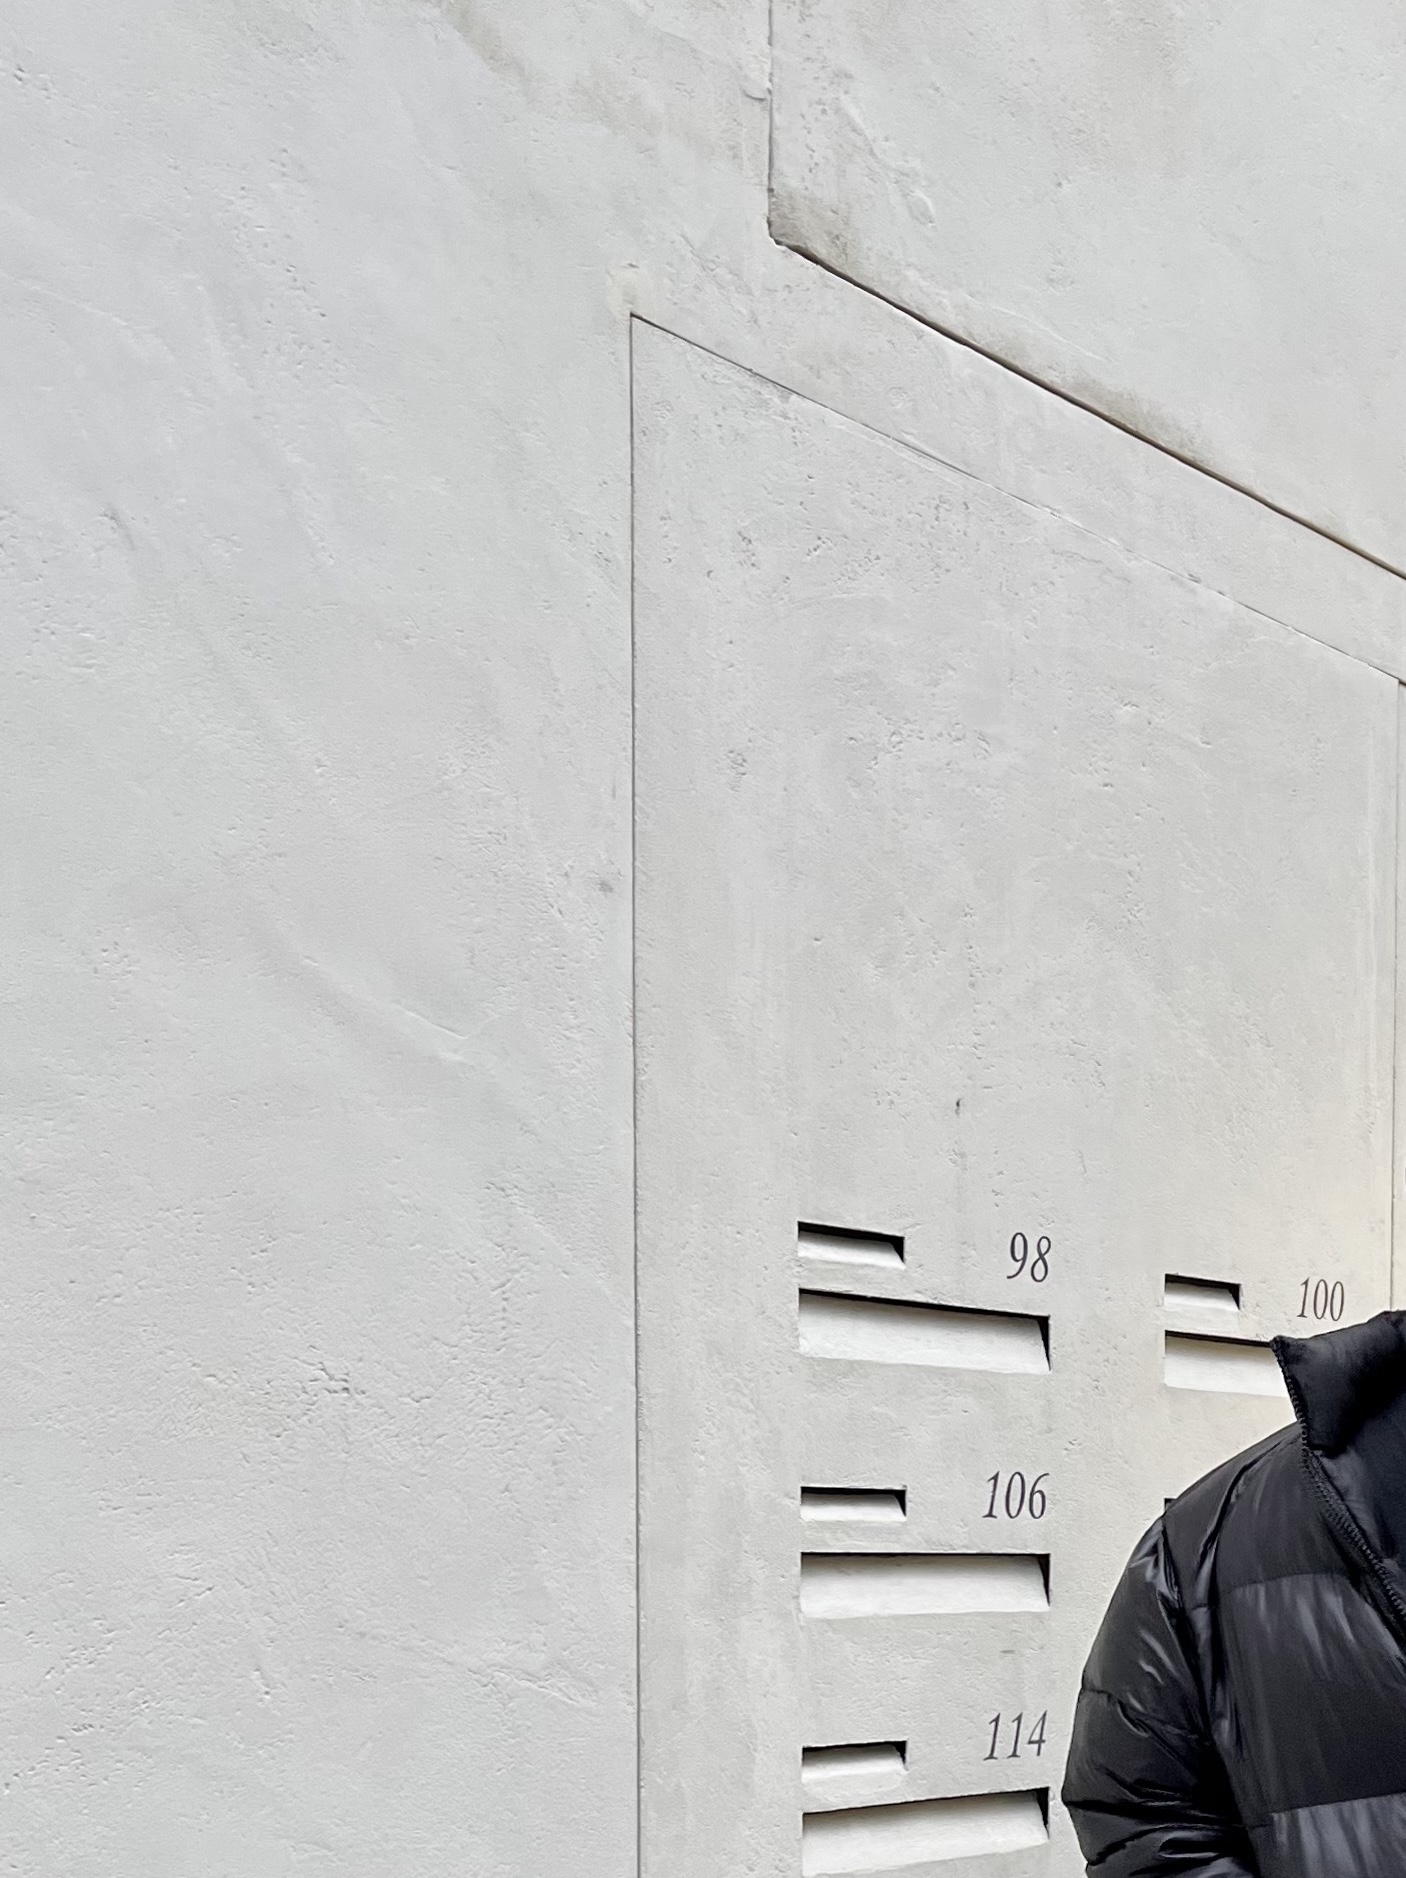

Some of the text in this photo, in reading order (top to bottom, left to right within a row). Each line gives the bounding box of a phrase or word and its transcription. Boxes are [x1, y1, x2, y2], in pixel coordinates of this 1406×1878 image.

[1006, 1232, 1052, 1283] 98
[1296, 1277, 1345, 1322] 100
[982, 1471, 1050, 1520] 106
[983, 1711, 1048, 1761] 114
